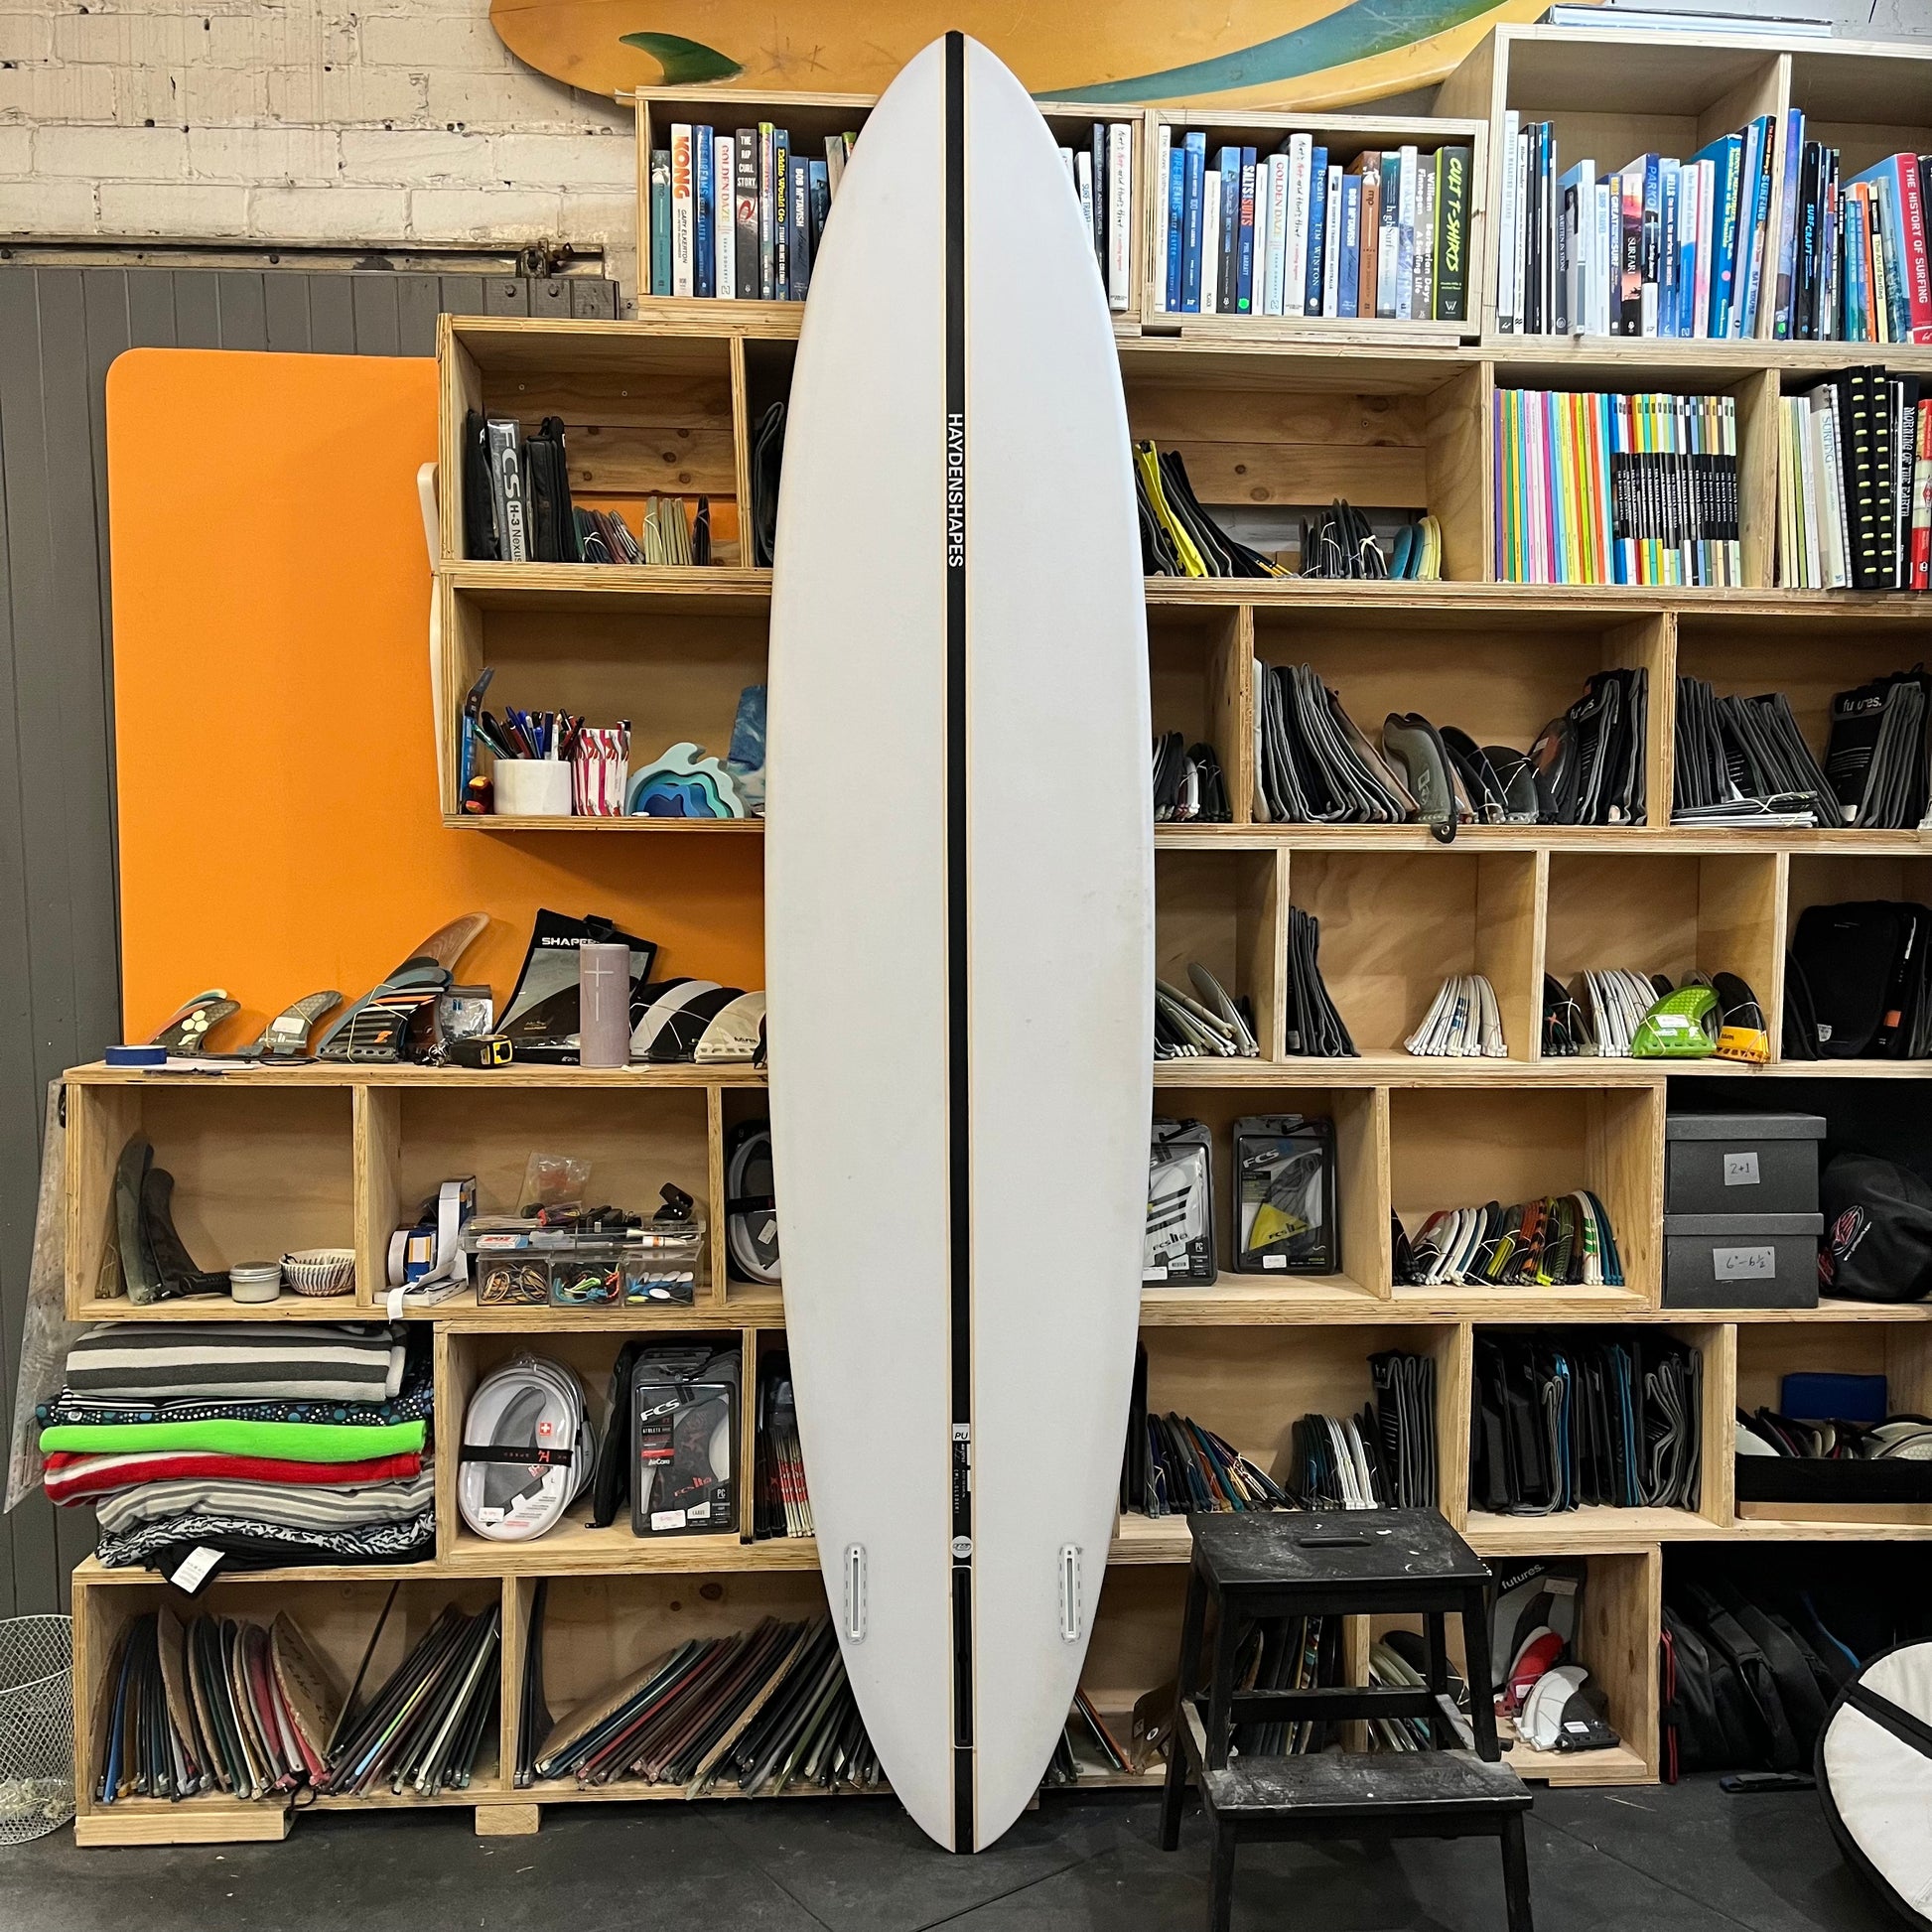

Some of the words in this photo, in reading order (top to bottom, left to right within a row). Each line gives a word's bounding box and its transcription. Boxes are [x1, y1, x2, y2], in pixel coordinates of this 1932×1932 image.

[741, 135, 752, 145] THE
[673, 136, 690, 199] KONG
[721, 145, 730, 191] GOLDEN
[739, 163, 755, 173] CURL
[741, 150, 752, 160] RIP
[1173, 151, 1183, 173] PIPE
[698, 158, 709, 195] DREAMS
[737, 177, 756, 187] STORY
[795, 168, 804, 186] BOB
[1242, 165, 1255, 194] SALTS
[1275, 162, 1284, 207] GOLDEN
[1315, 170, 1325, 202] Breath
[1447, 157, 1462, 199] CULT
[1647, 165, 1657, 207] PARKO
[1666, 174, 1676, 197] BELLS
[1905, 167, 1916, 188] THE
[1172, 176, 1182, 210] DREAMS
[1189, 198, 1198, 209] 100
[1347, 188, 1356, 206] BOB
[1366, 190, 1374, 206] mp
[1416, 168, 1427, 214] Finnegan
[1426, 172, 1435, 211] William
[1729, 177, 1738, 221] MEMORIES
[1756, 174, 1770, 220] SURFING
[721, 194, 730, 221] DAZE
[777, 208, 785, 222] Go
[1241, 198, 1254, 226] SUITS
[1610, 196, 1619, 224] GREAT
[1907, 192, 1920, 236] HISTORY
[1273, 208, 1283, 238] DAZE
[1446, 200, 1461, 272] T-SHIRTS
[1722, 216, 1730, 248] Seaside
[1413, 239, 1424, 274] Surfing
[1423, 223, 1434, 274] Barbarian
[1610, 243, 1619, 266] SURF
[1627, 236, 1637, 274] SURFARI
[1913, 240, 1922, 254] OF
[1312, 245, 1321, 286] WINTON
[1415, 277, 1424, 294] Life
[1422, 277, 1433, 303] Days
[1914, 257, 1928, 304] SURFING
[1821, 416, 1834, 463] SURFING
[1902, 406, 1915, 451] MORNING
[499, 423, 520, 499] FCS
[1901, 452, 1913, 464] OF
[1901, 466, 1912, 483] THE
[948, 413, 963, 568] HAYDENSHAPES
[1901, 485, 1912, 517] EARTH
[509, 504, 520, 526] H-3
[511, 529, 523, 562] Nexus
[1242, 1149, 1280, 1169] FCS
[1729, 1163, 1750, 1174] 2+1
[639, 1398, 680, 1421] FCS
[954, 1432, 969, 1441] PU
[717, 1488, 726, 1498] PC
[1501, 1562, 1545, 1589] futures.
